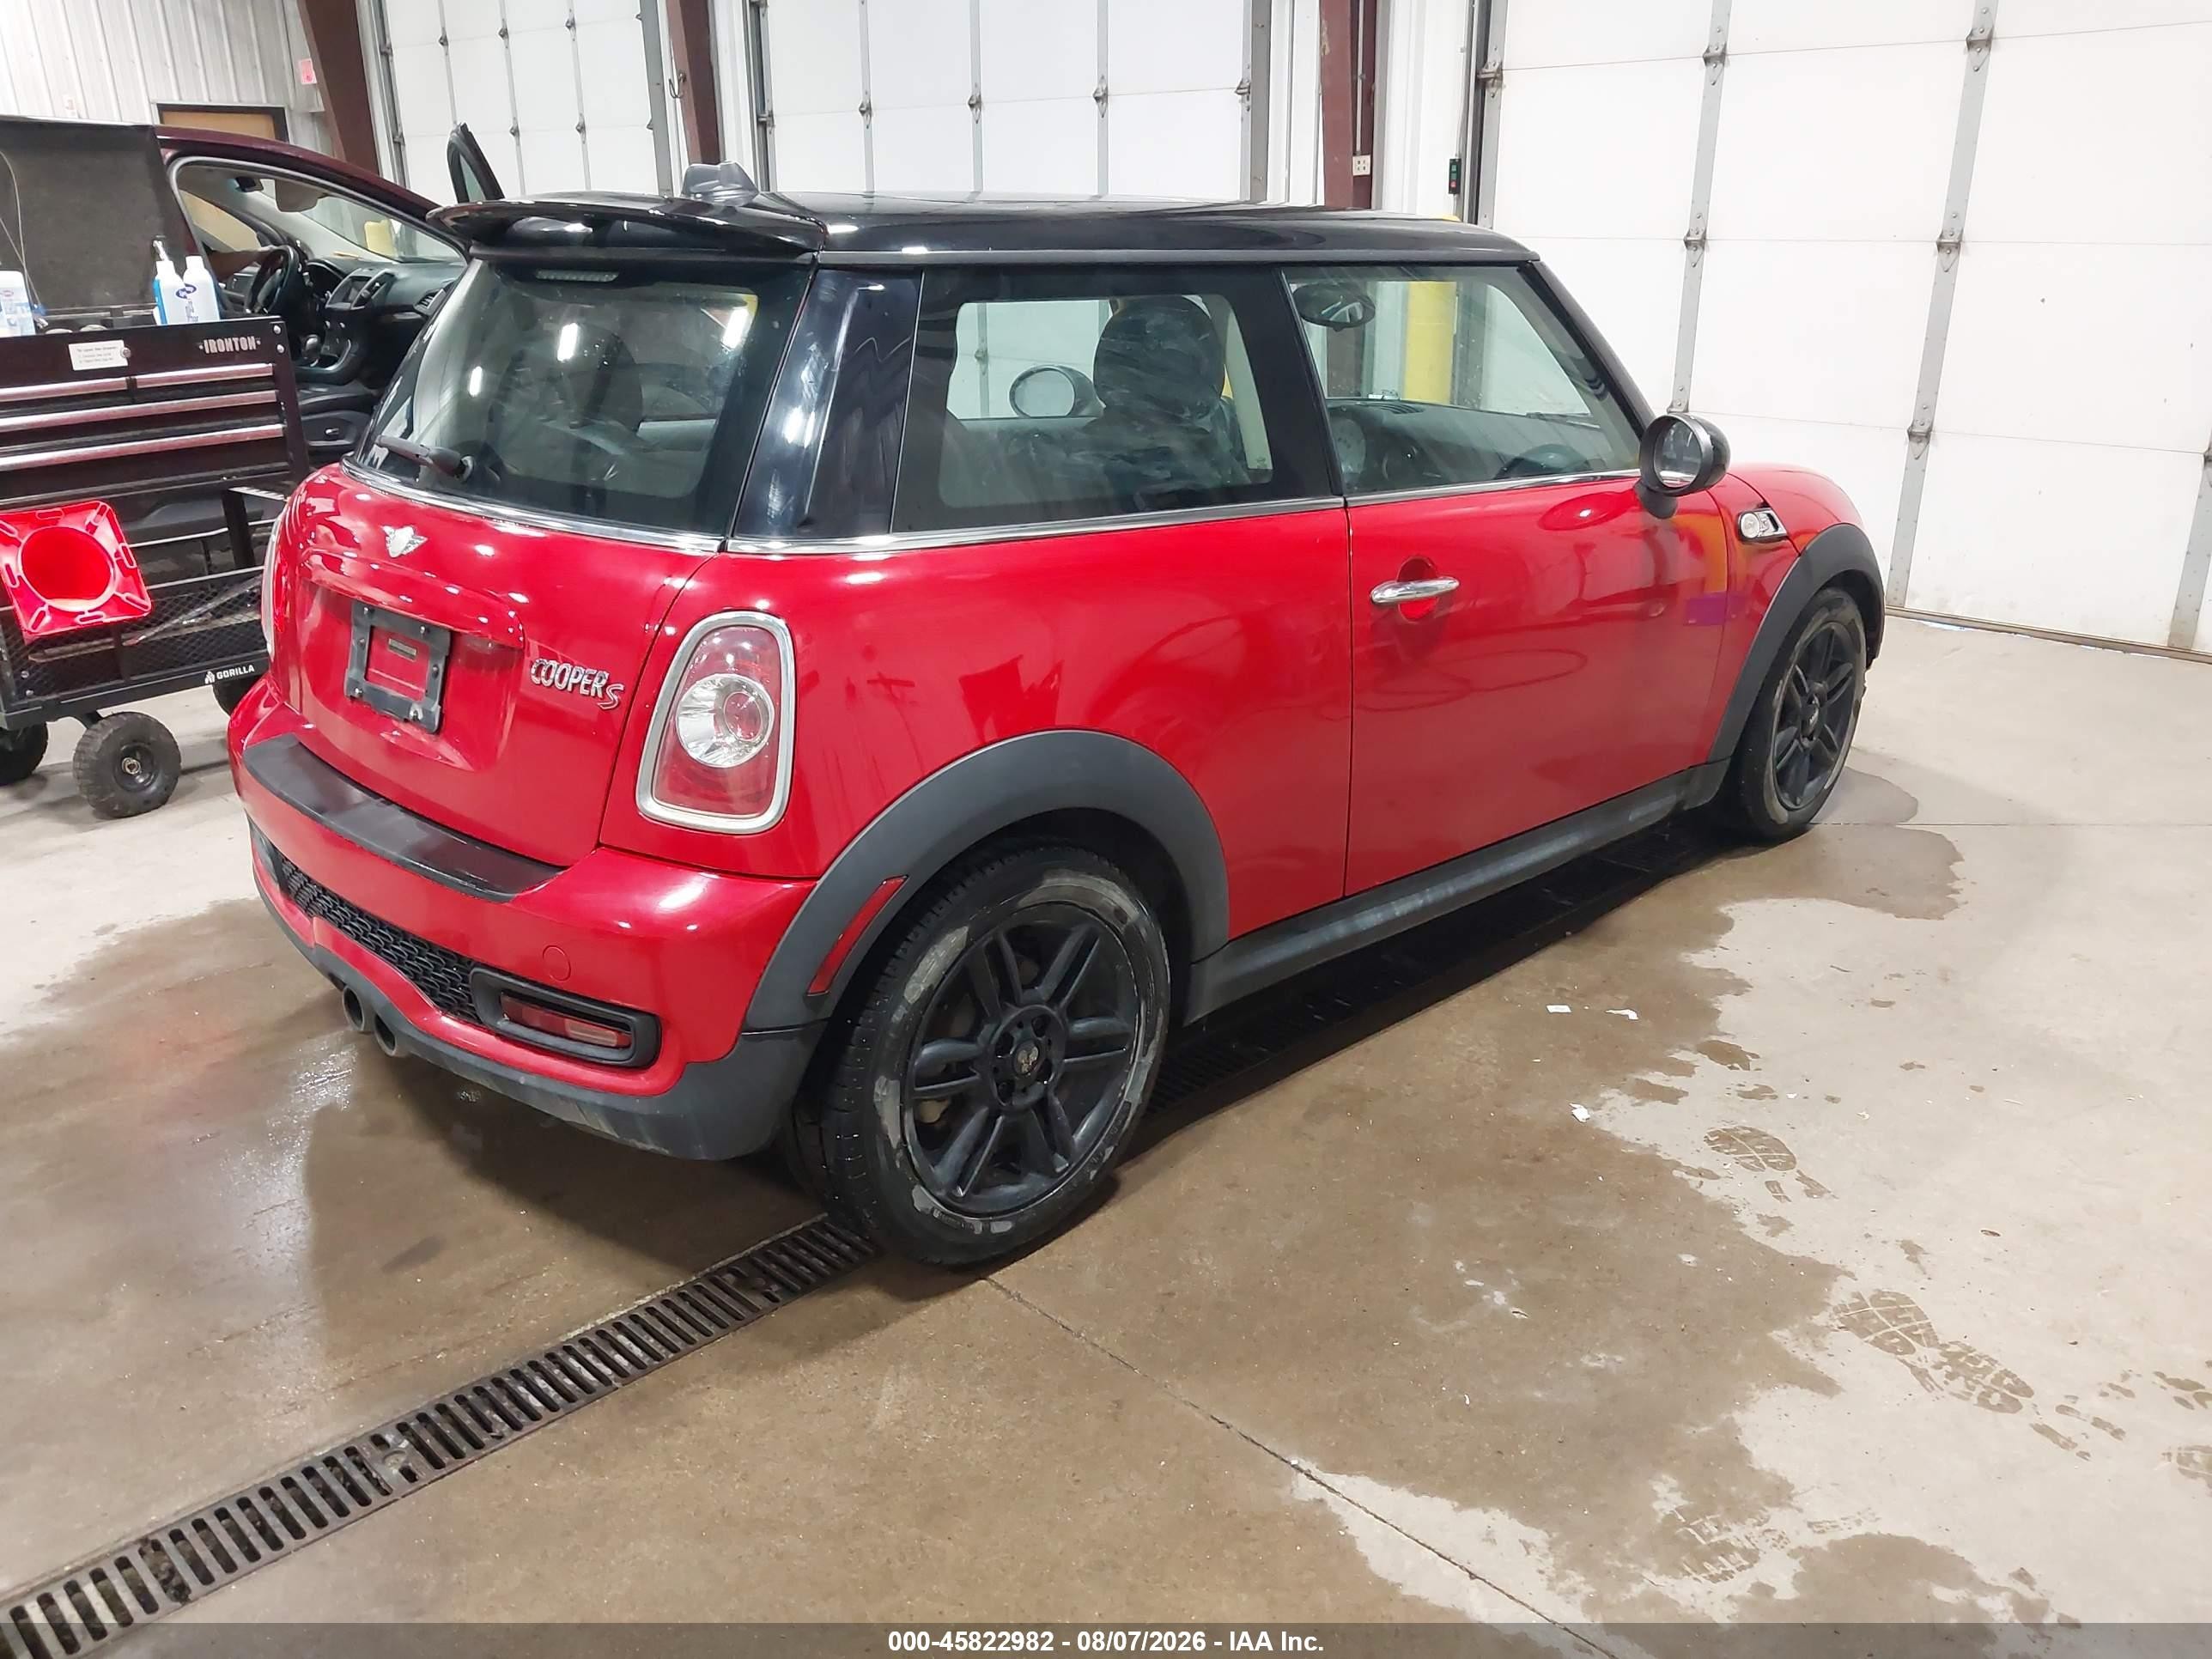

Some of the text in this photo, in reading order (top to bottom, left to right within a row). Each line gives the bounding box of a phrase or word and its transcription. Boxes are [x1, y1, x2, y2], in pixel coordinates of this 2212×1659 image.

[203, 336, 257, 354] IRONTON
[216, 664, 255, 679] GORILLA
[531, 658, 624, 710] COOPER S
